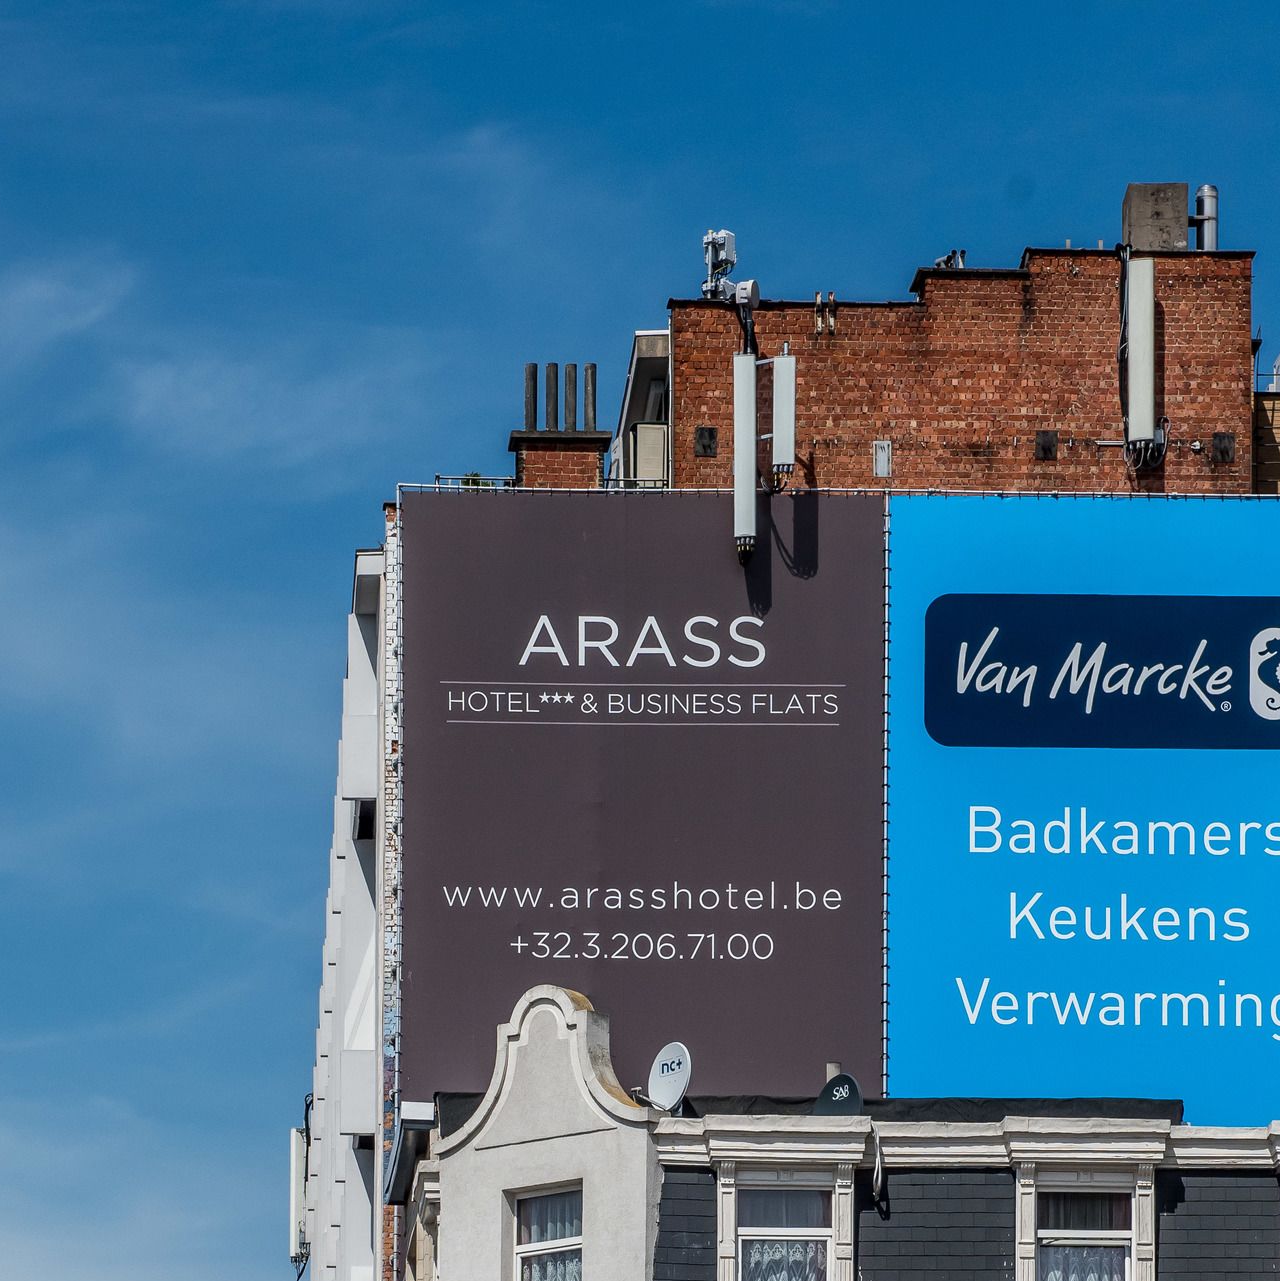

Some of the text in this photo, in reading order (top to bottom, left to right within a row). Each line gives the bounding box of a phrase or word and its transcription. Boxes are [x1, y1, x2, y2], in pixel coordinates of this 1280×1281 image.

[518, 615, 766, 668] ARASS
[956, 626, 1233, 714] Van Marcke
[580, 693, 598, 715] &
[608, 693, 742, 715] BUSINESS
[752, 694, 839, 715] FLATS
[443, 880, 842, 911] www.arasshotel.be
[1010, 892, 1250, 941] Keukens
[510, 932, 775, 961] +32.3.206.71.00
